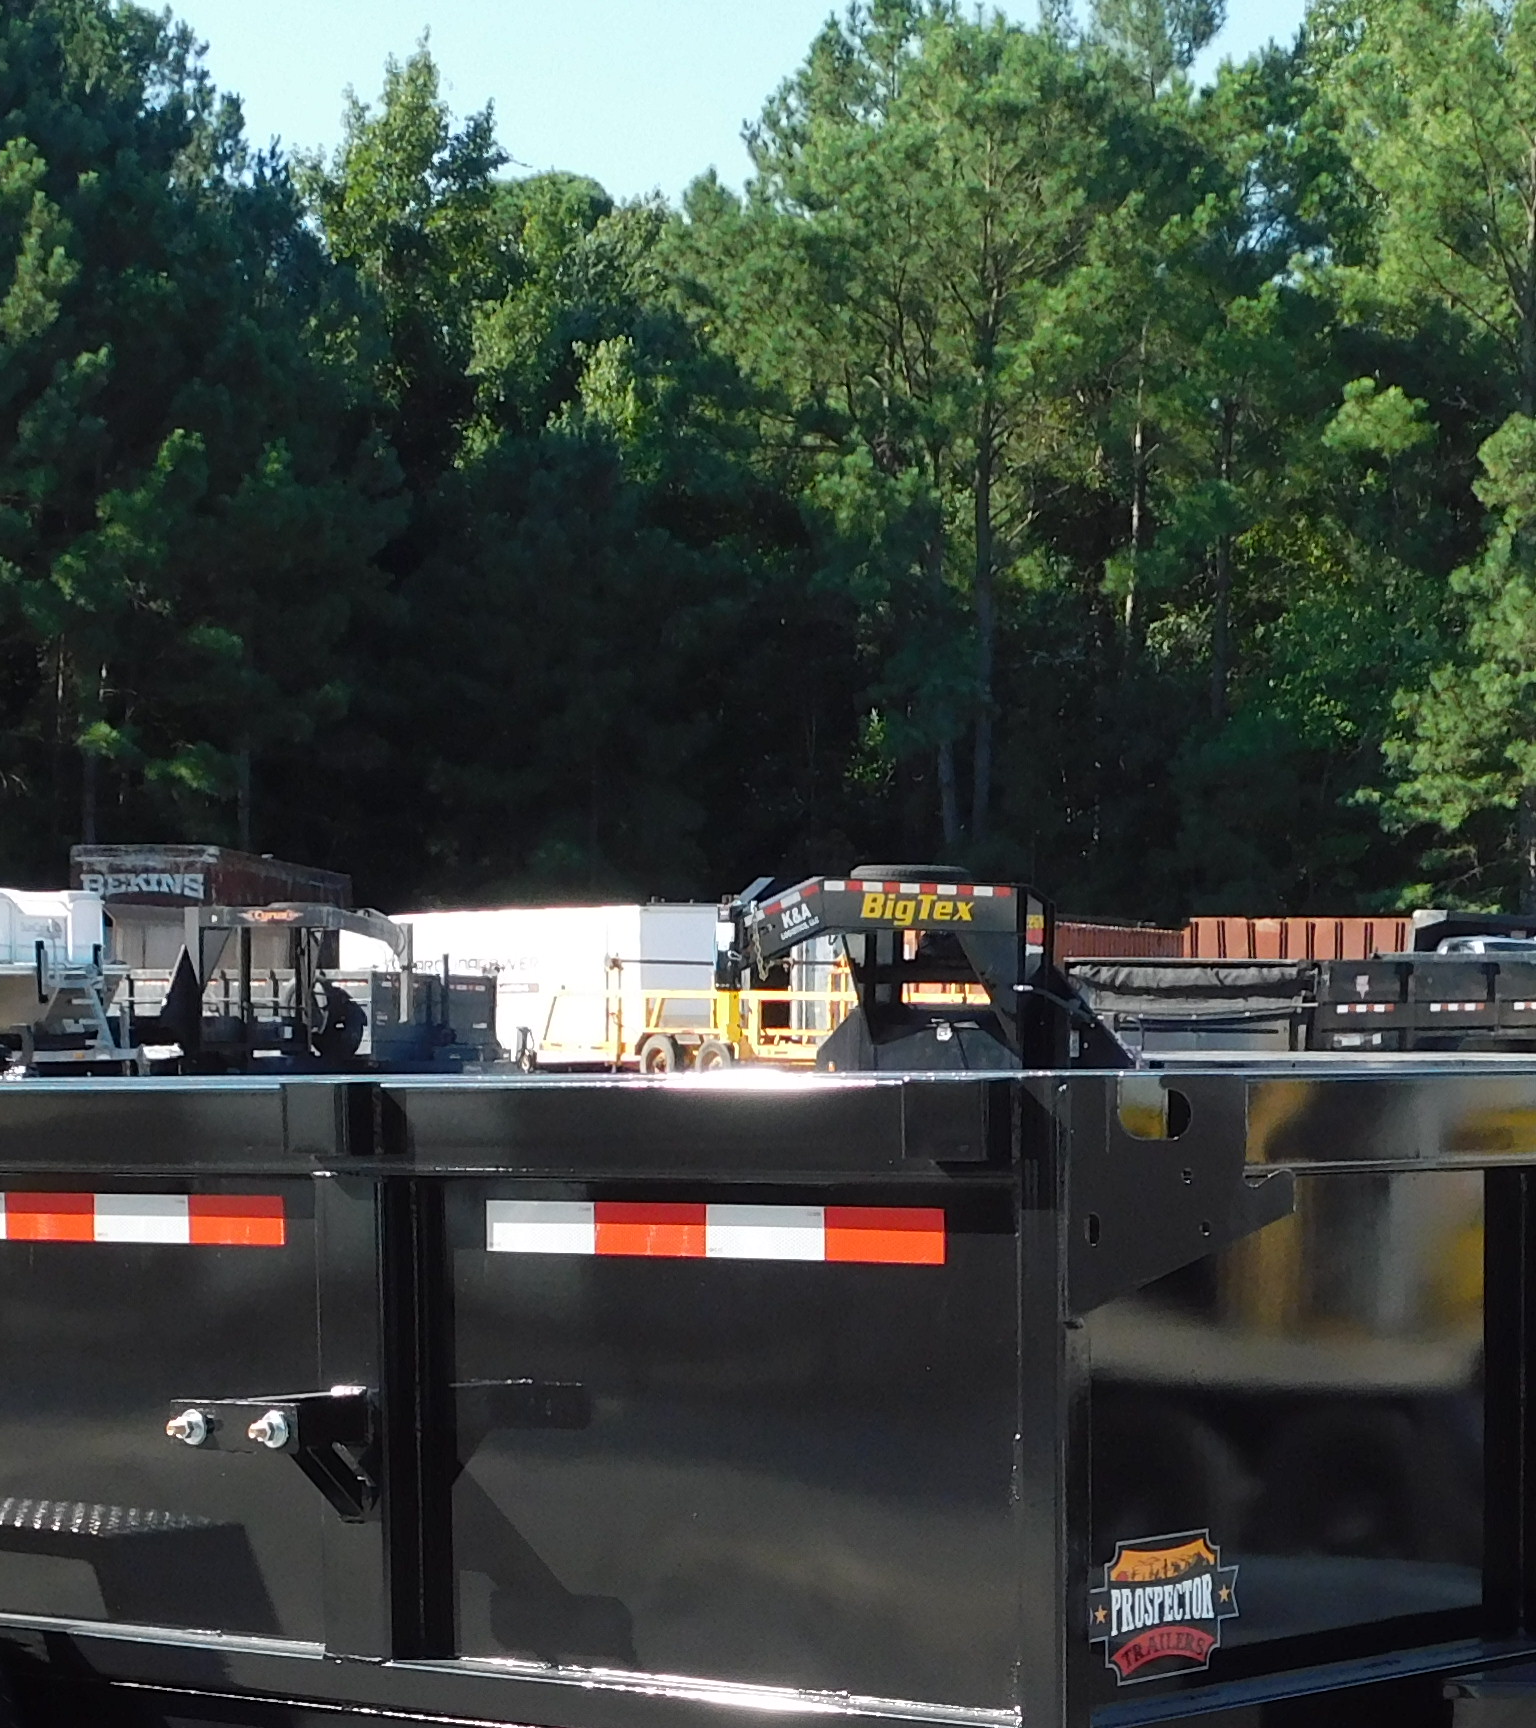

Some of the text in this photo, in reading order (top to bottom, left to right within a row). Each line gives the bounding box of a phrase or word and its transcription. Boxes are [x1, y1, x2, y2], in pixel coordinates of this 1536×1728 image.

[81, 873, 204, 900] BEKINS
[781, 903, 812, 929] K&A
[860, 892, 974, 926] BigTex
[1110, 1573, 1215, 1637] PROSPECTOR
[1119, 1631, 1208, 1668] TRAILERS
